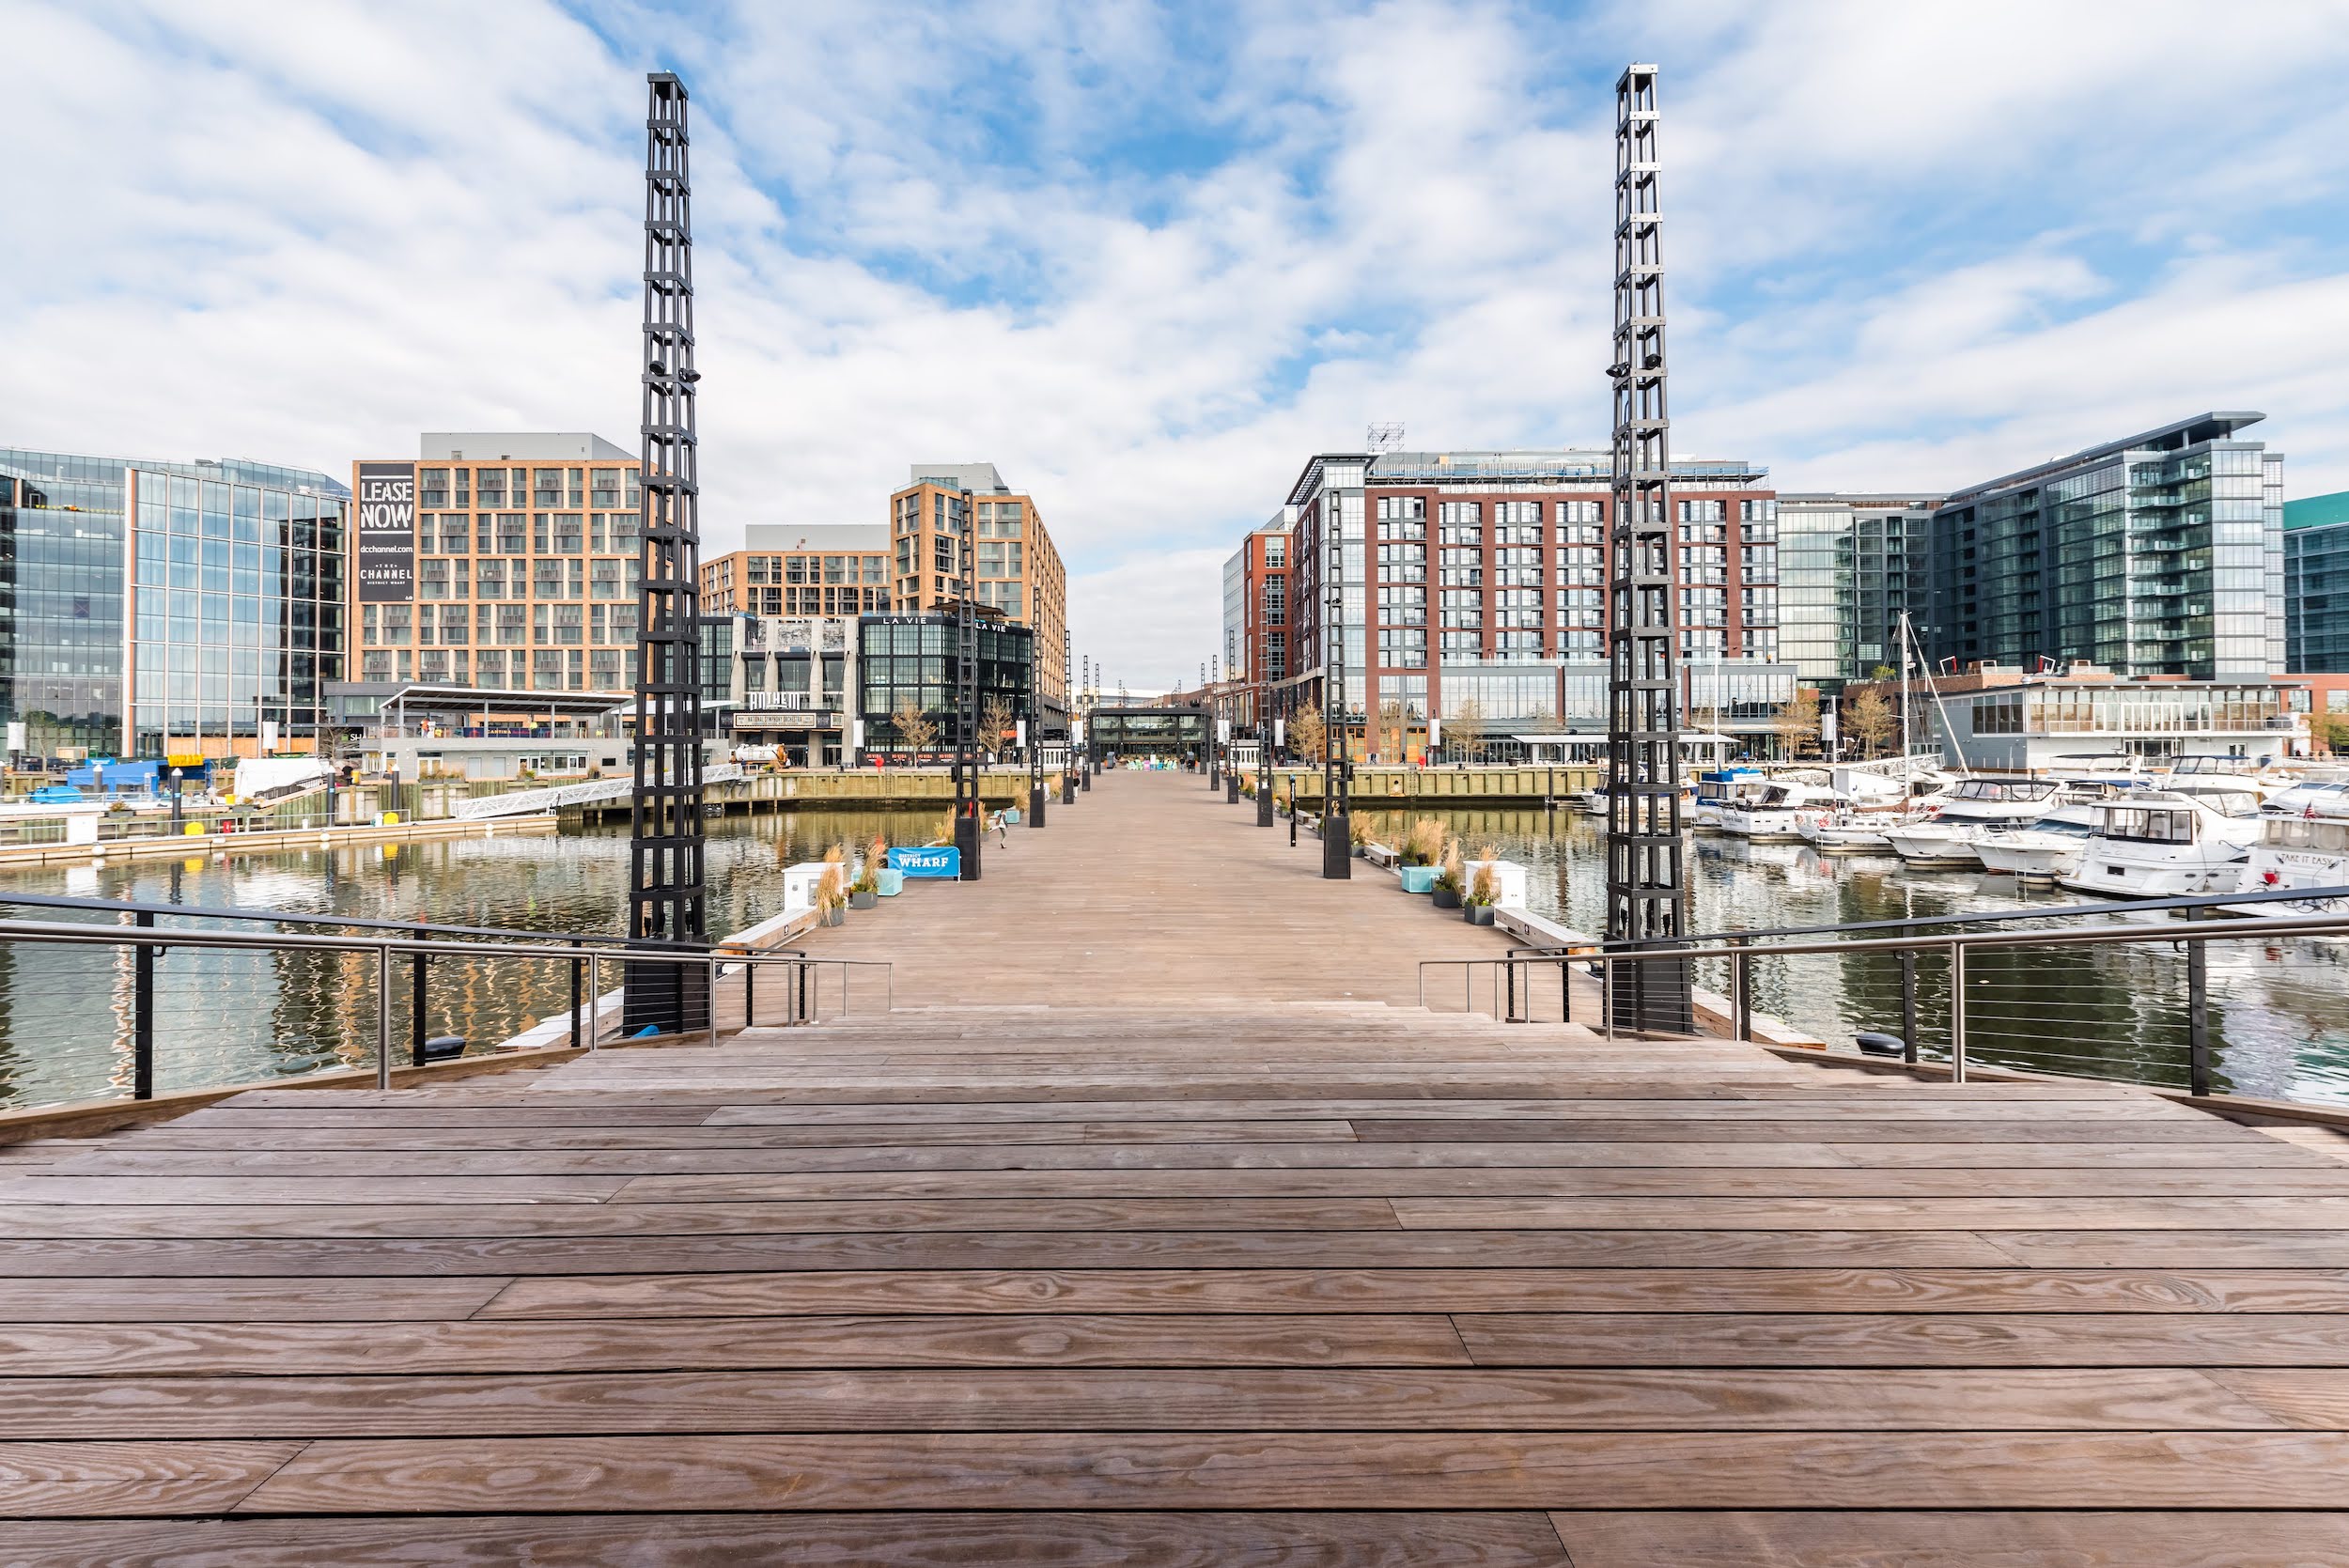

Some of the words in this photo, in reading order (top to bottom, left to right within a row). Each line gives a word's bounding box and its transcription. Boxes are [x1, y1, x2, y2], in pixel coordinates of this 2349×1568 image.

[361, 482, 413, 502] LEASE
[361, 504, 413, 528] NOW
[360, 545, 413, 553] dcchannel.com
[360, 569, 413, 580] CHANNEL
[991, 624, 1006, 633] VIE
[750, 691, 800, 710] ANTHEM
[898, 857, 949, 867] WHARF
[2281, 853, 2299, 862] TAKE
[2302, 855, 2310, 863] IT
[2311, 856, 2332, 865] EASY
